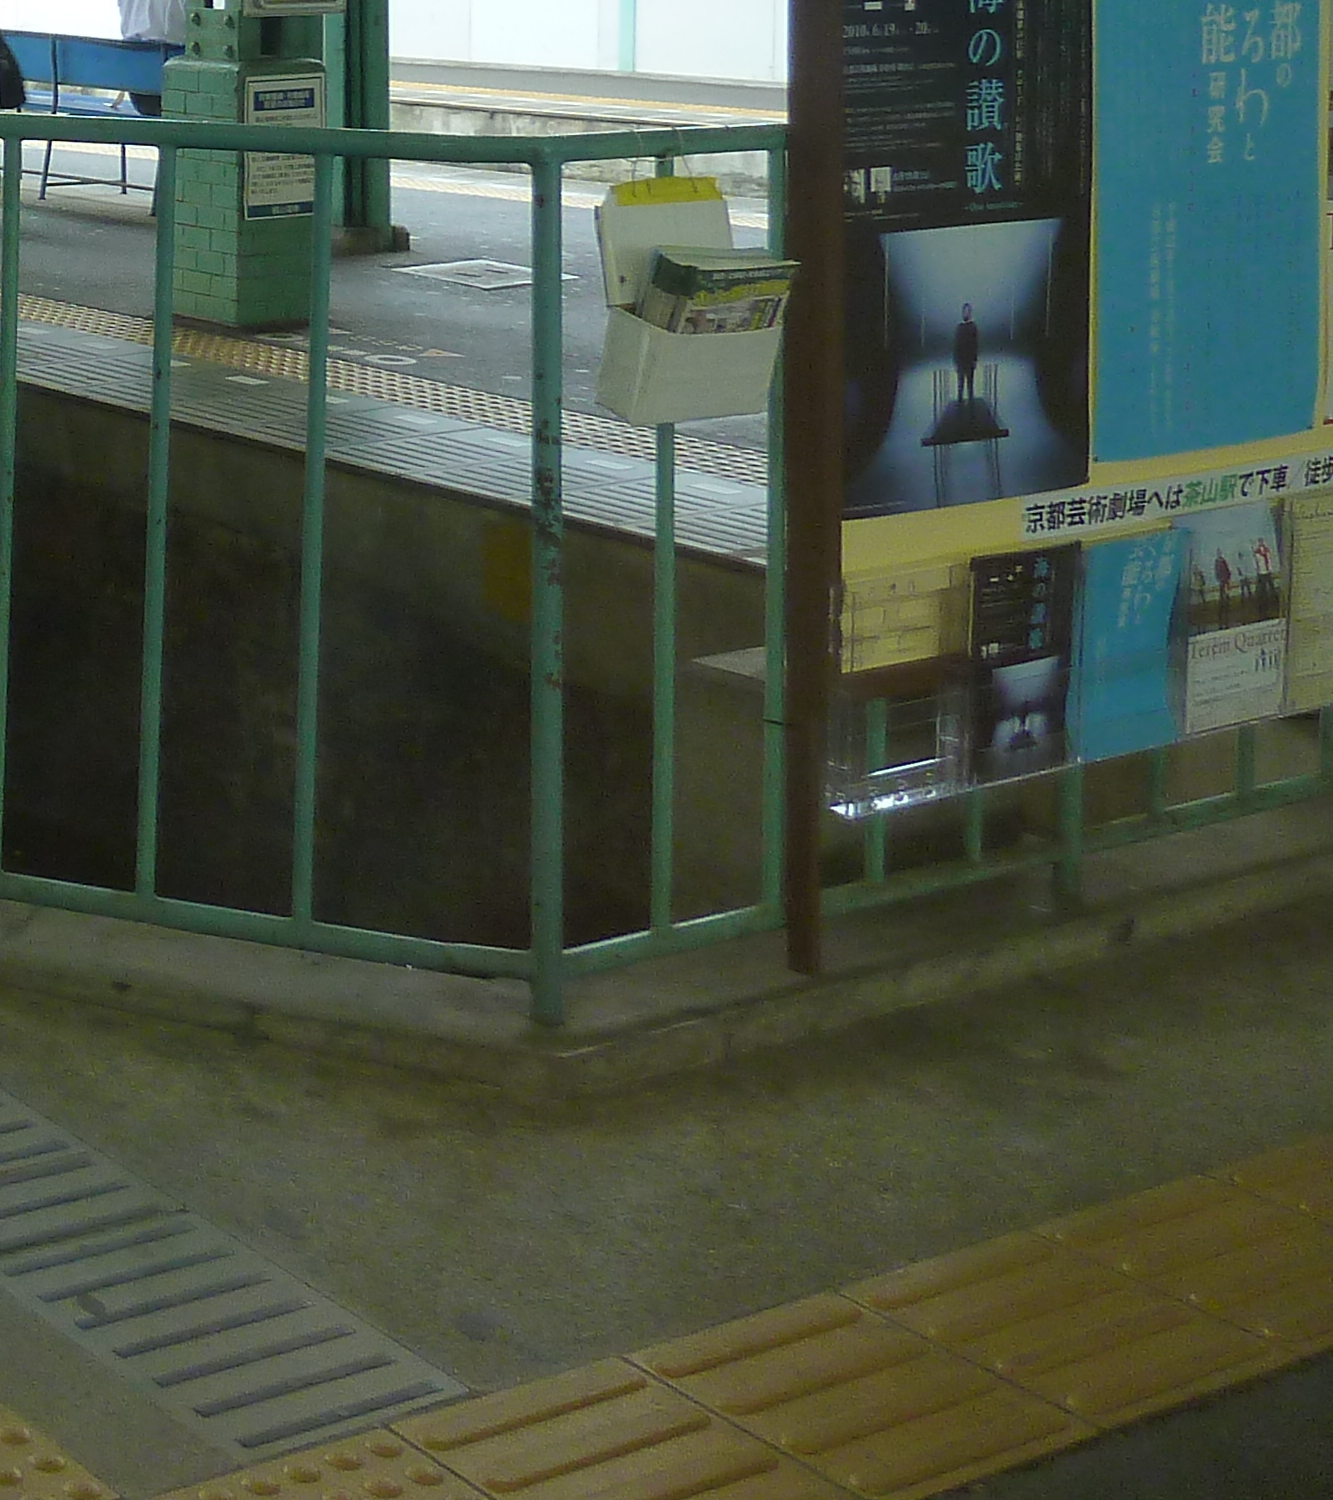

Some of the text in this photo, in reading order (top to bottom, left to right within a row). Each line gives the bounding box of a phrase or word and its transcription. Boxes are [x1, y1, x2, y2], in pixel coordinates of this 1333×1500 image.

[1025, 465, 1289, 534] 京都芸術劇場へは茶山駅で下車
